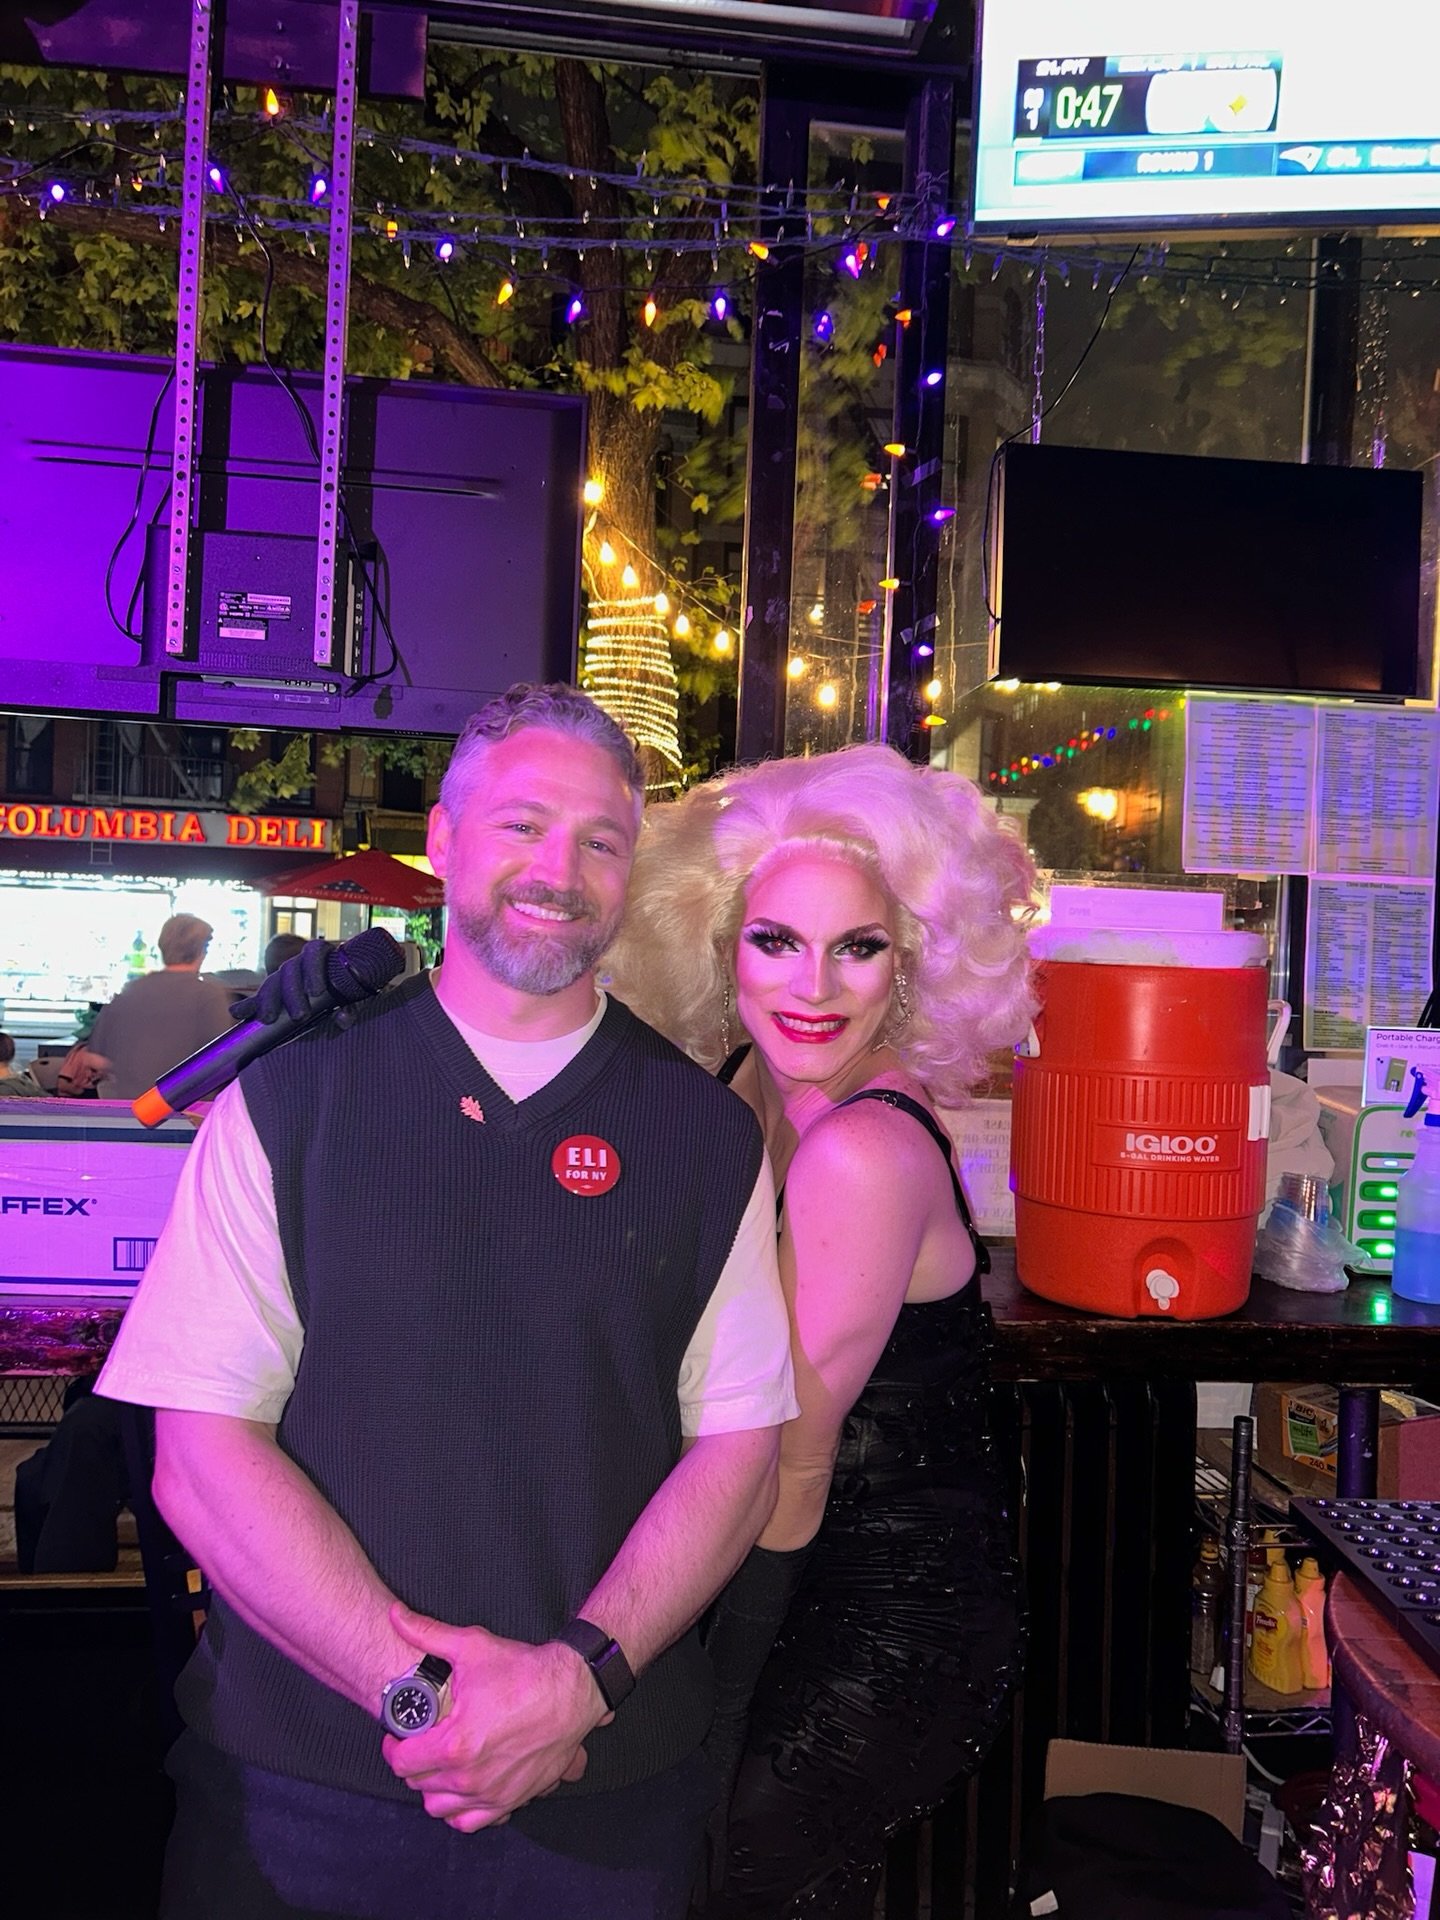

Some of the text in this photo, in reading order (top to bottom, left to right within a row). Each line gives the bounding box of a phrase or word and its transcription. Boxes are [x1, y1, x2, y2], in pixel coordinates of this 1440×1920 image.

[1056, 85, 1123, 128] 0:47
[225, 814, 327, 849] DELI
[1376, 1033, 1414, 1042] Portable
[1126, 1133, 1216, 1155] IGLOO
[568, 1147, 607, 1168] ELI
[1151, 1154, 1192, 1162] DRINKING
[566, 1170, 607, 1181] FOR NY
[0, 1196, 91, 1217] FFEX
[1295, 1405, 1313, 1416] BIC
[1310, 1458, 1325, 1470] 240
